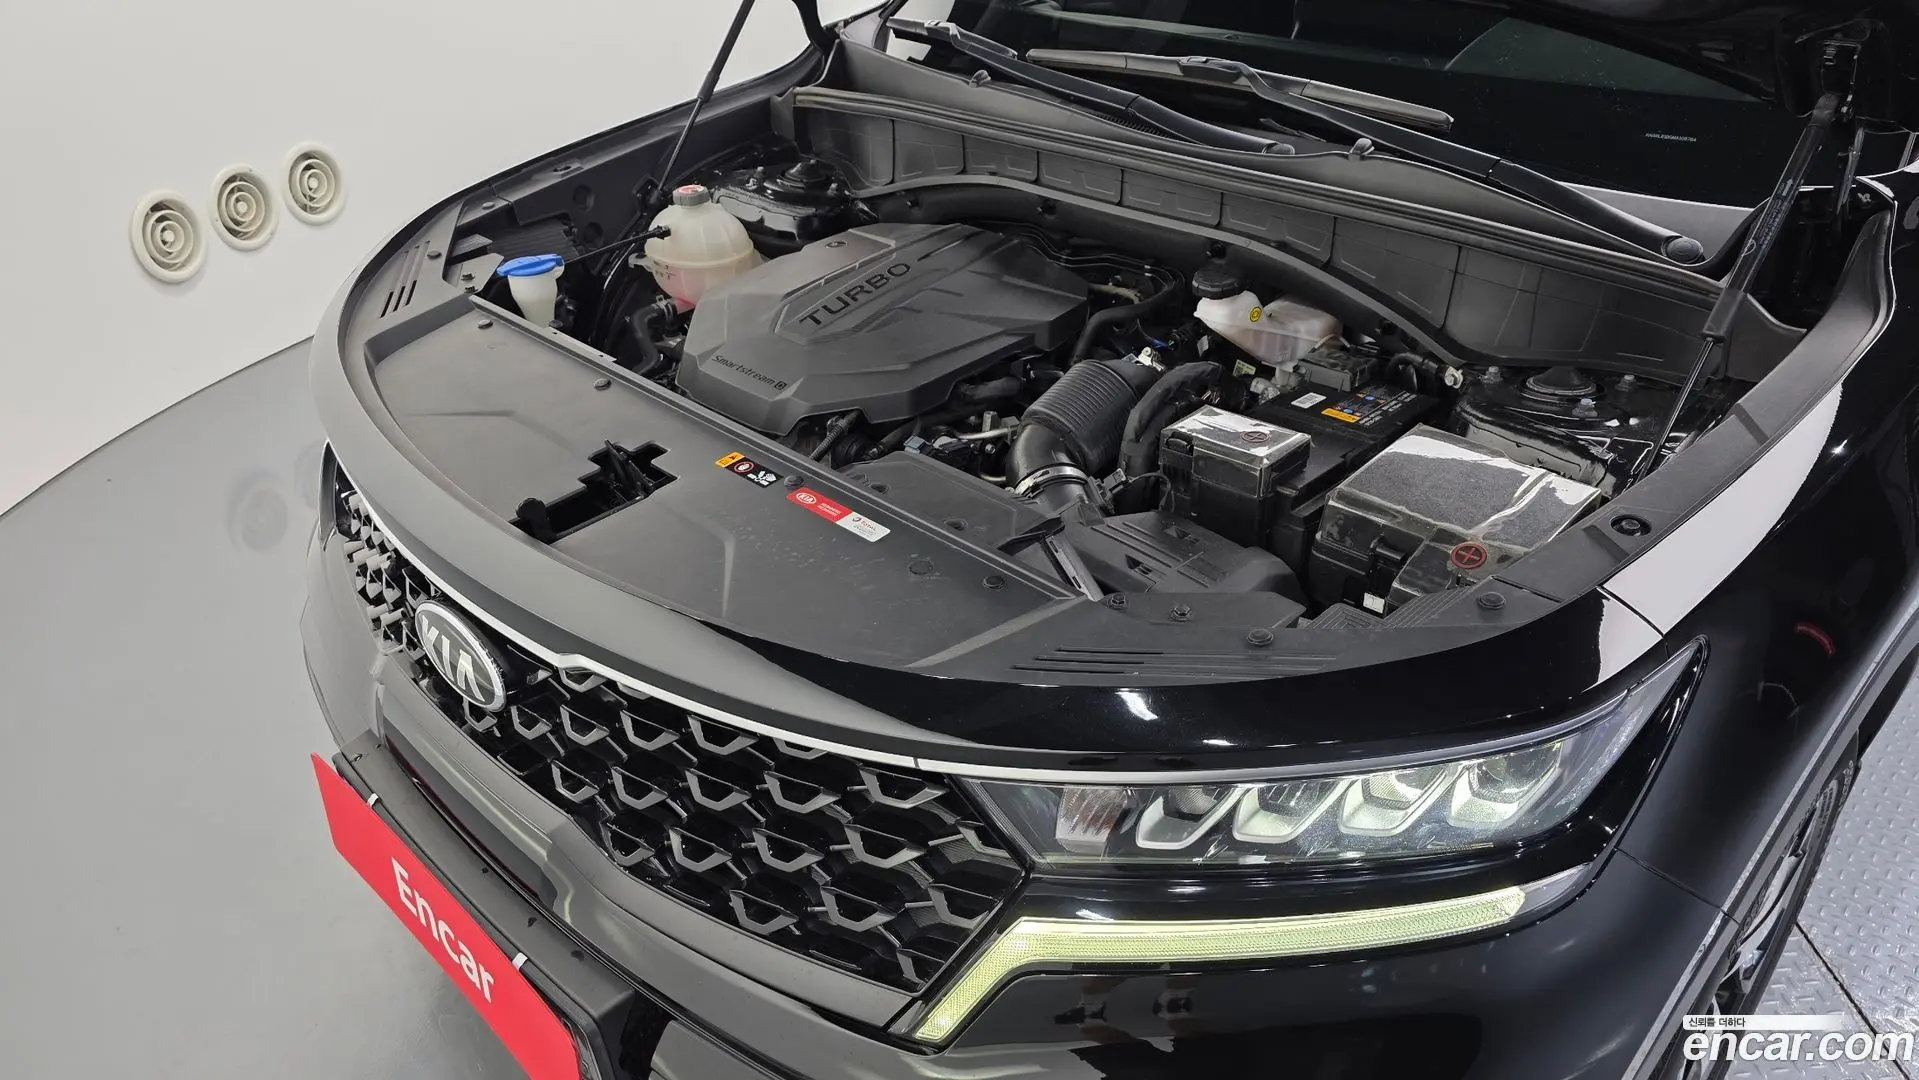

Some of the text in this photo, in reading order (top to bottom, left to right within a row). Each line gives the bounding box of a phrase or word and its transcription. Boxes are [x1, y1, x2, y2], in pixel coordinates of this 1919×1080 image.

[799, 263, 911, 325] TURBO
[711, 354, 775, 387] Smartstream
[422, 615, 486, 702] KIA
[391, 857, 495, 1003] Encar
